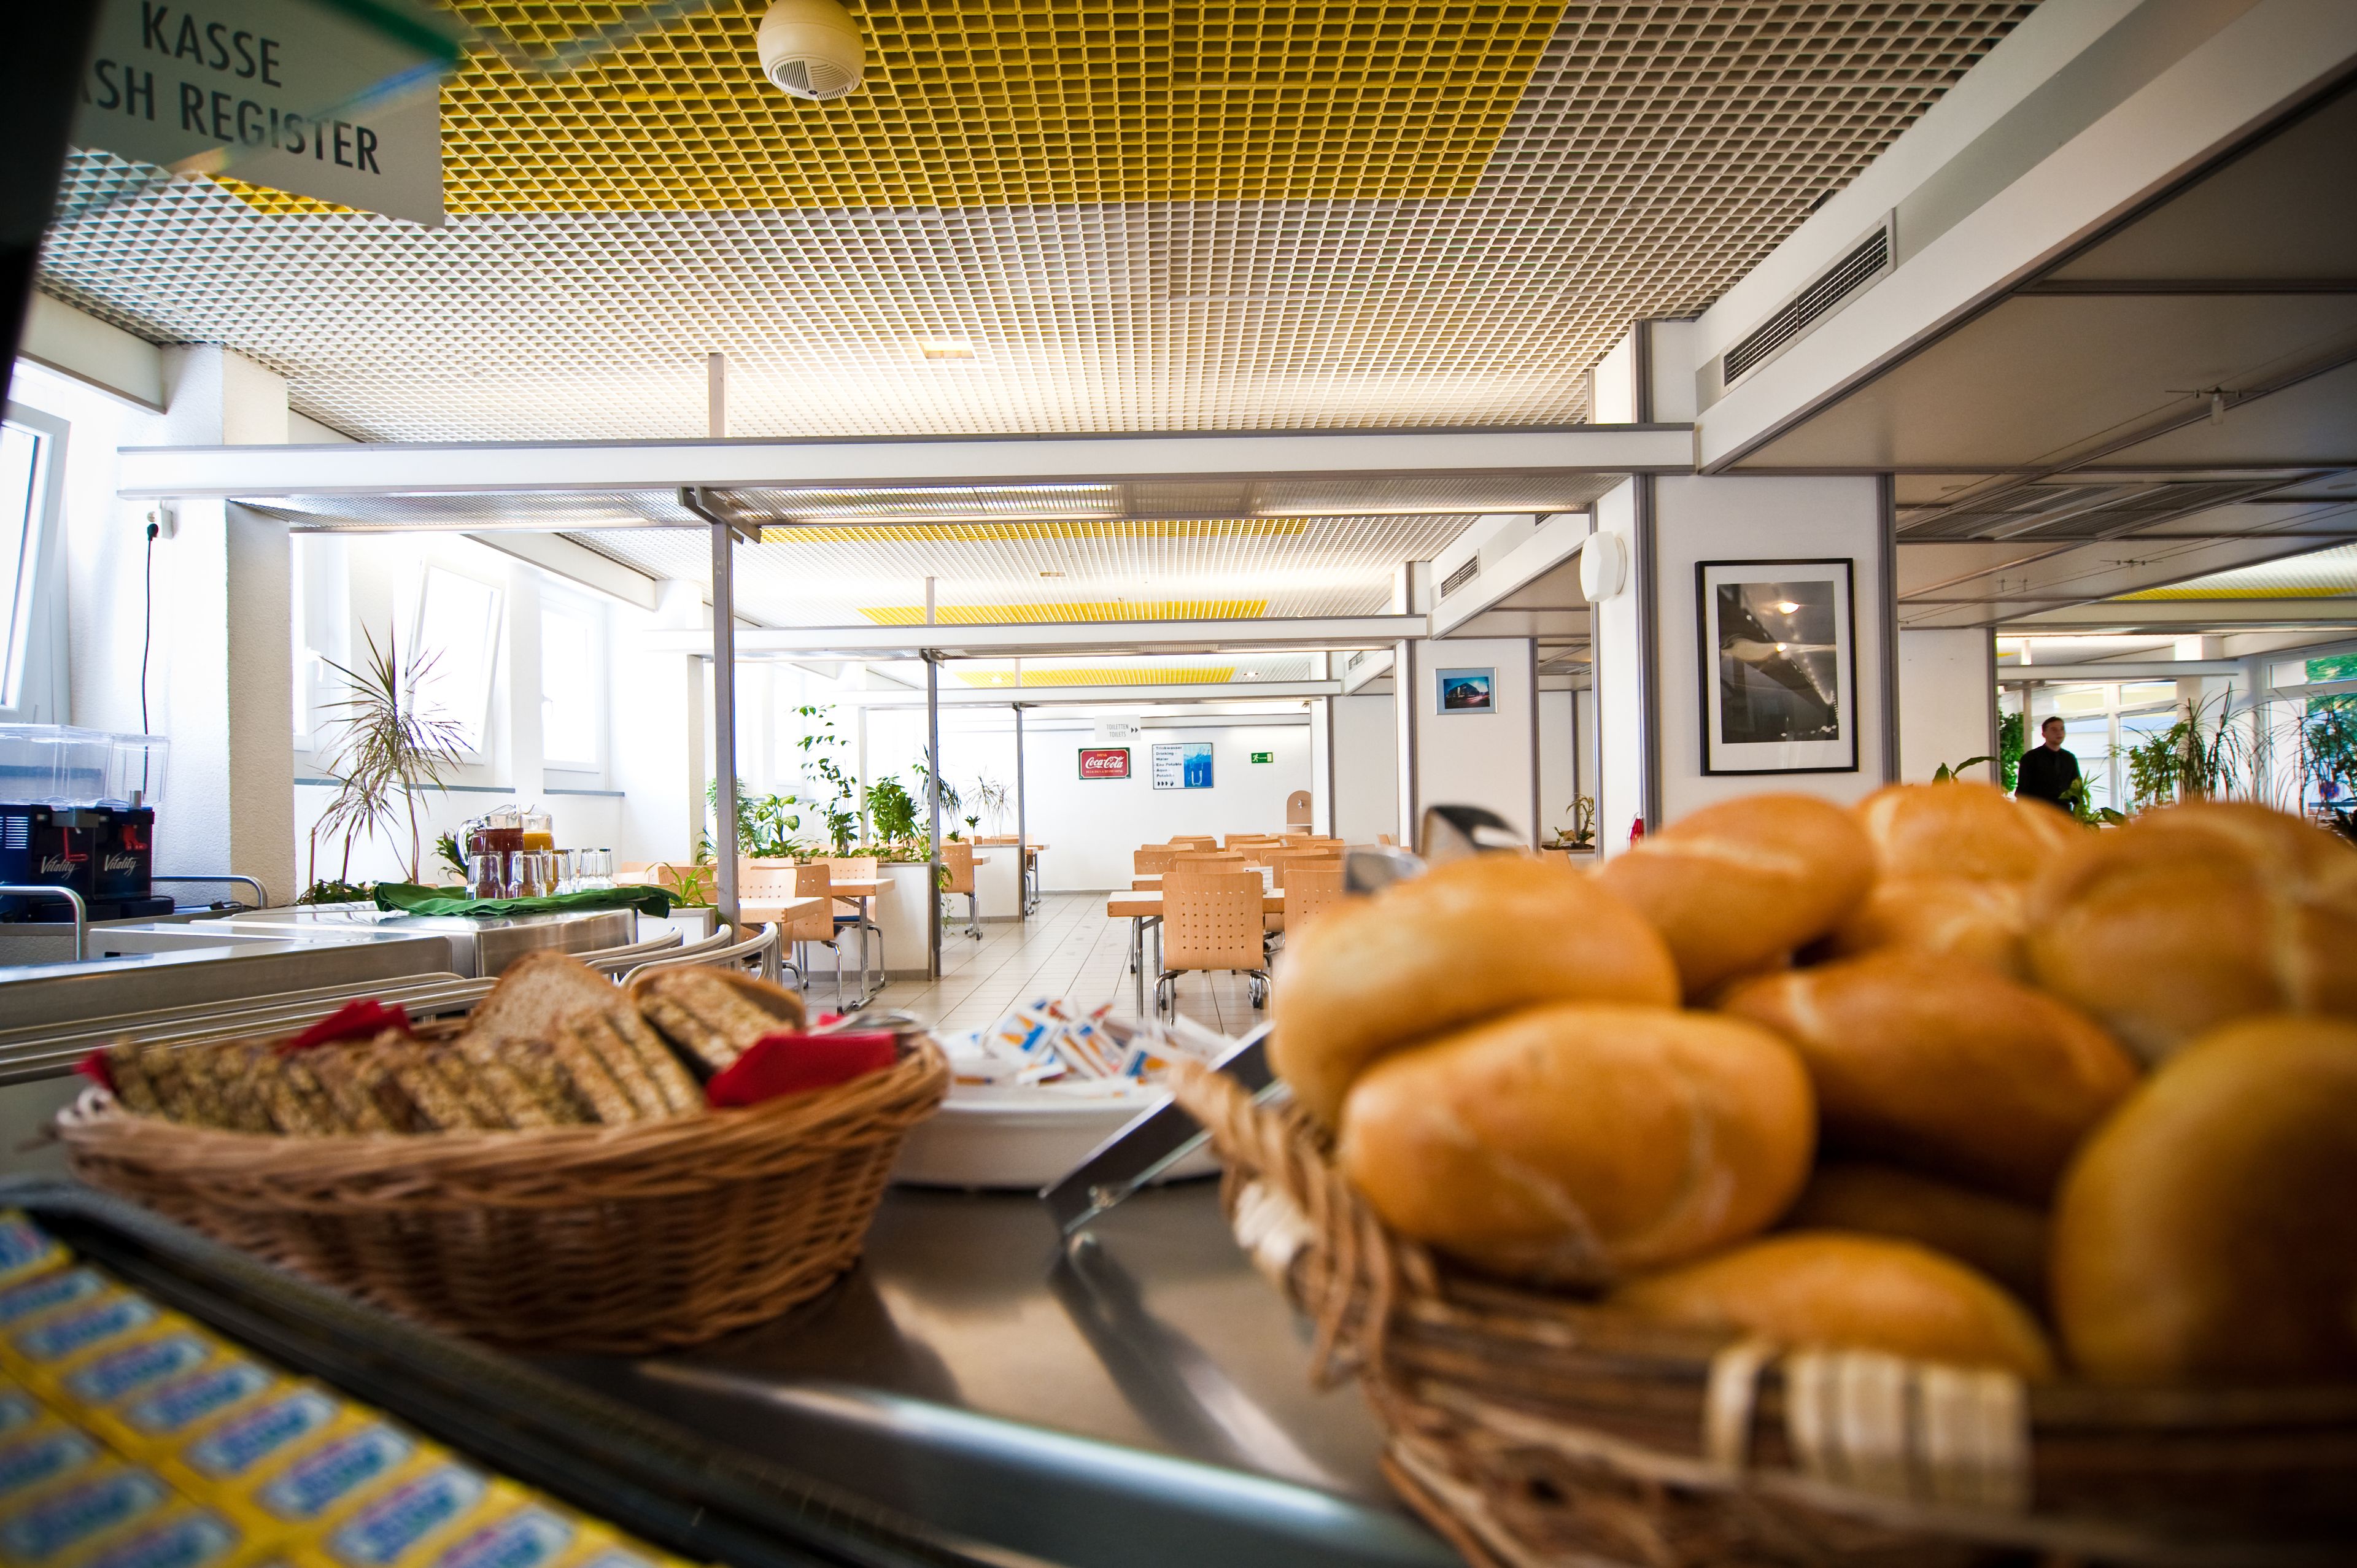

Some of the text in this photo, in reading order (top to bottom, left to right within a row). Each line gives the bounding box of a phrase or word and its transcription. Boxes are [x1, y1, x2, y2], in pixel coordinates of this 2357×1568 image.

[141, 1, 282, 88] KASSE
[77, 59, 381, 175] SH REGISTER
[1085, 756, 1124, 769] Coca-Cola
[41, 852, 81, 881] Vitality
[104, 852, 142, 876] Vitality
